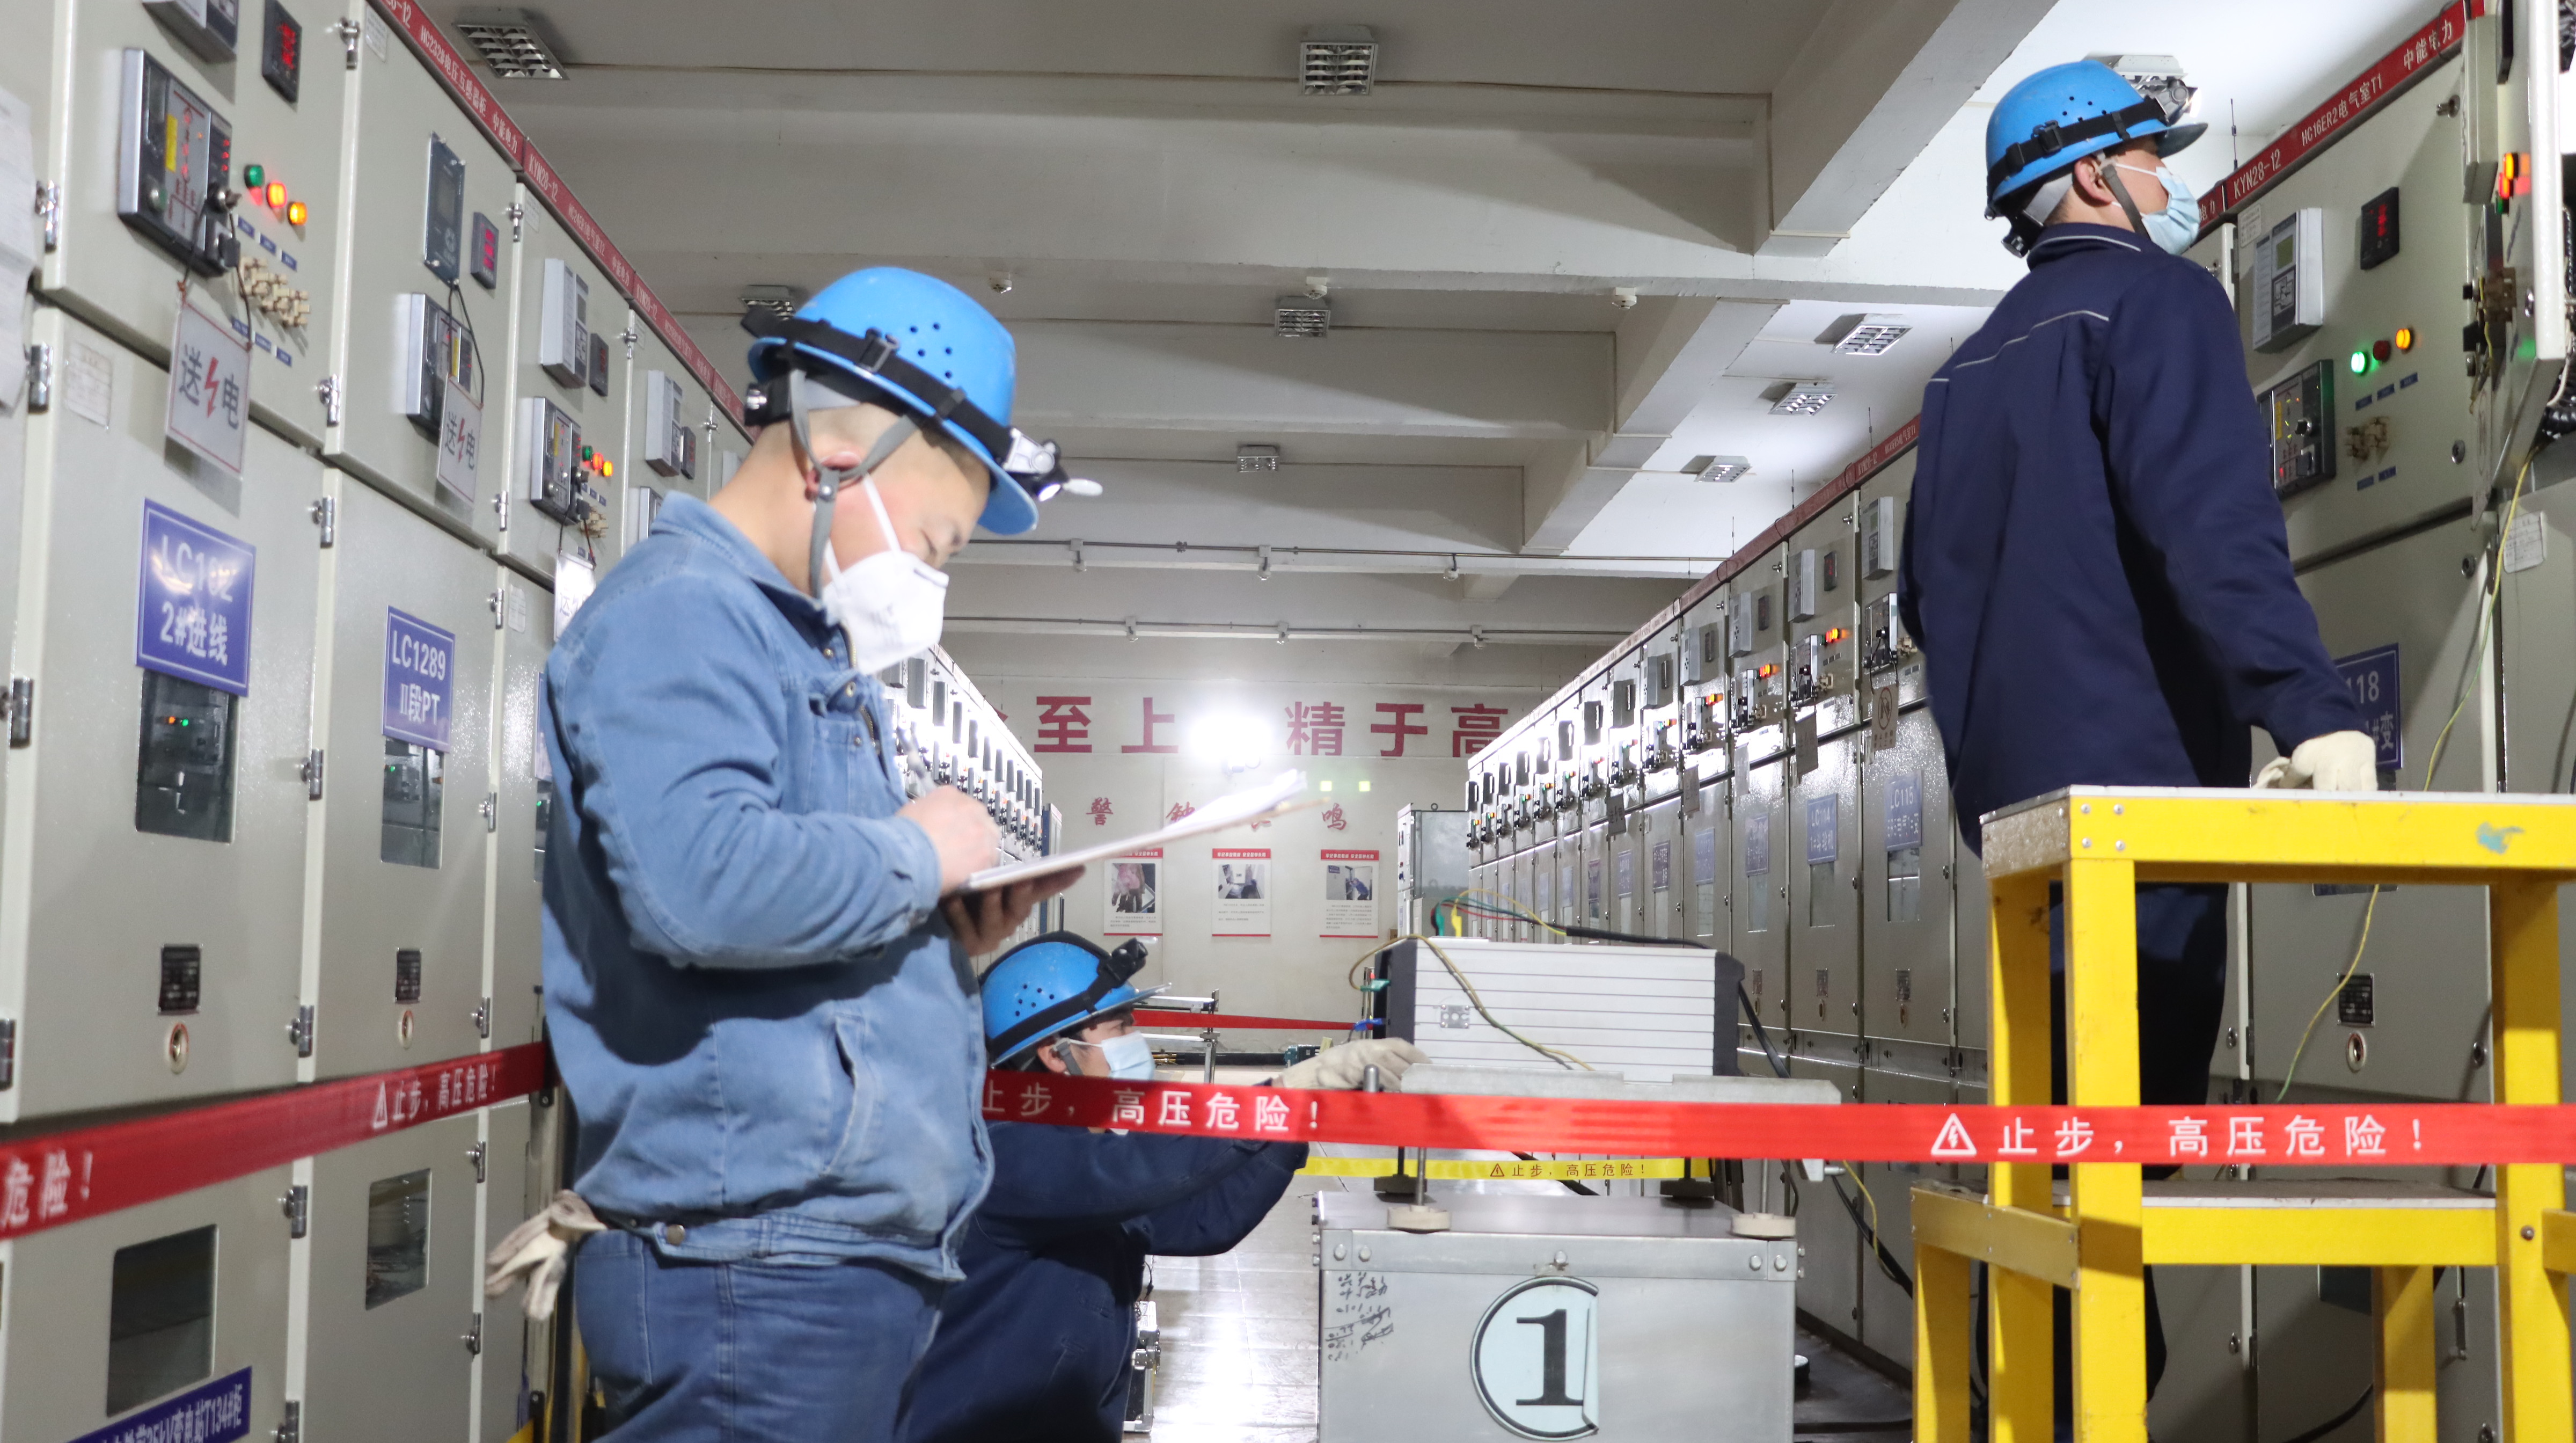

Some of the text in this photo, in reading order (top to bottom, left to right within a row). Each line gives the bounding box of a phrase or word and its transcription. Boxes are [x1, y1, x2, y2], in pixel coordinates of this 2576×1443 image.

[2234, 19, 2453, 200] KYN28-12 HC16ER2电气室T1 中能电力
[492, 111, 518, 154] 中能电力
[529, 154, 559, 203] KYN28-12
[392, 630, 447, 681] LC1289
[1086, 797, 1347, 831] 警钟鸣
[1890, 786, 1914, 810] LC115
[392, 1063, 496, 1121] 止步，高压危险！
[1997, 1114, 2423, 1157] 止步，高压危险！
[1511, 1163, 1645, 1177] 止步，高压危险！
